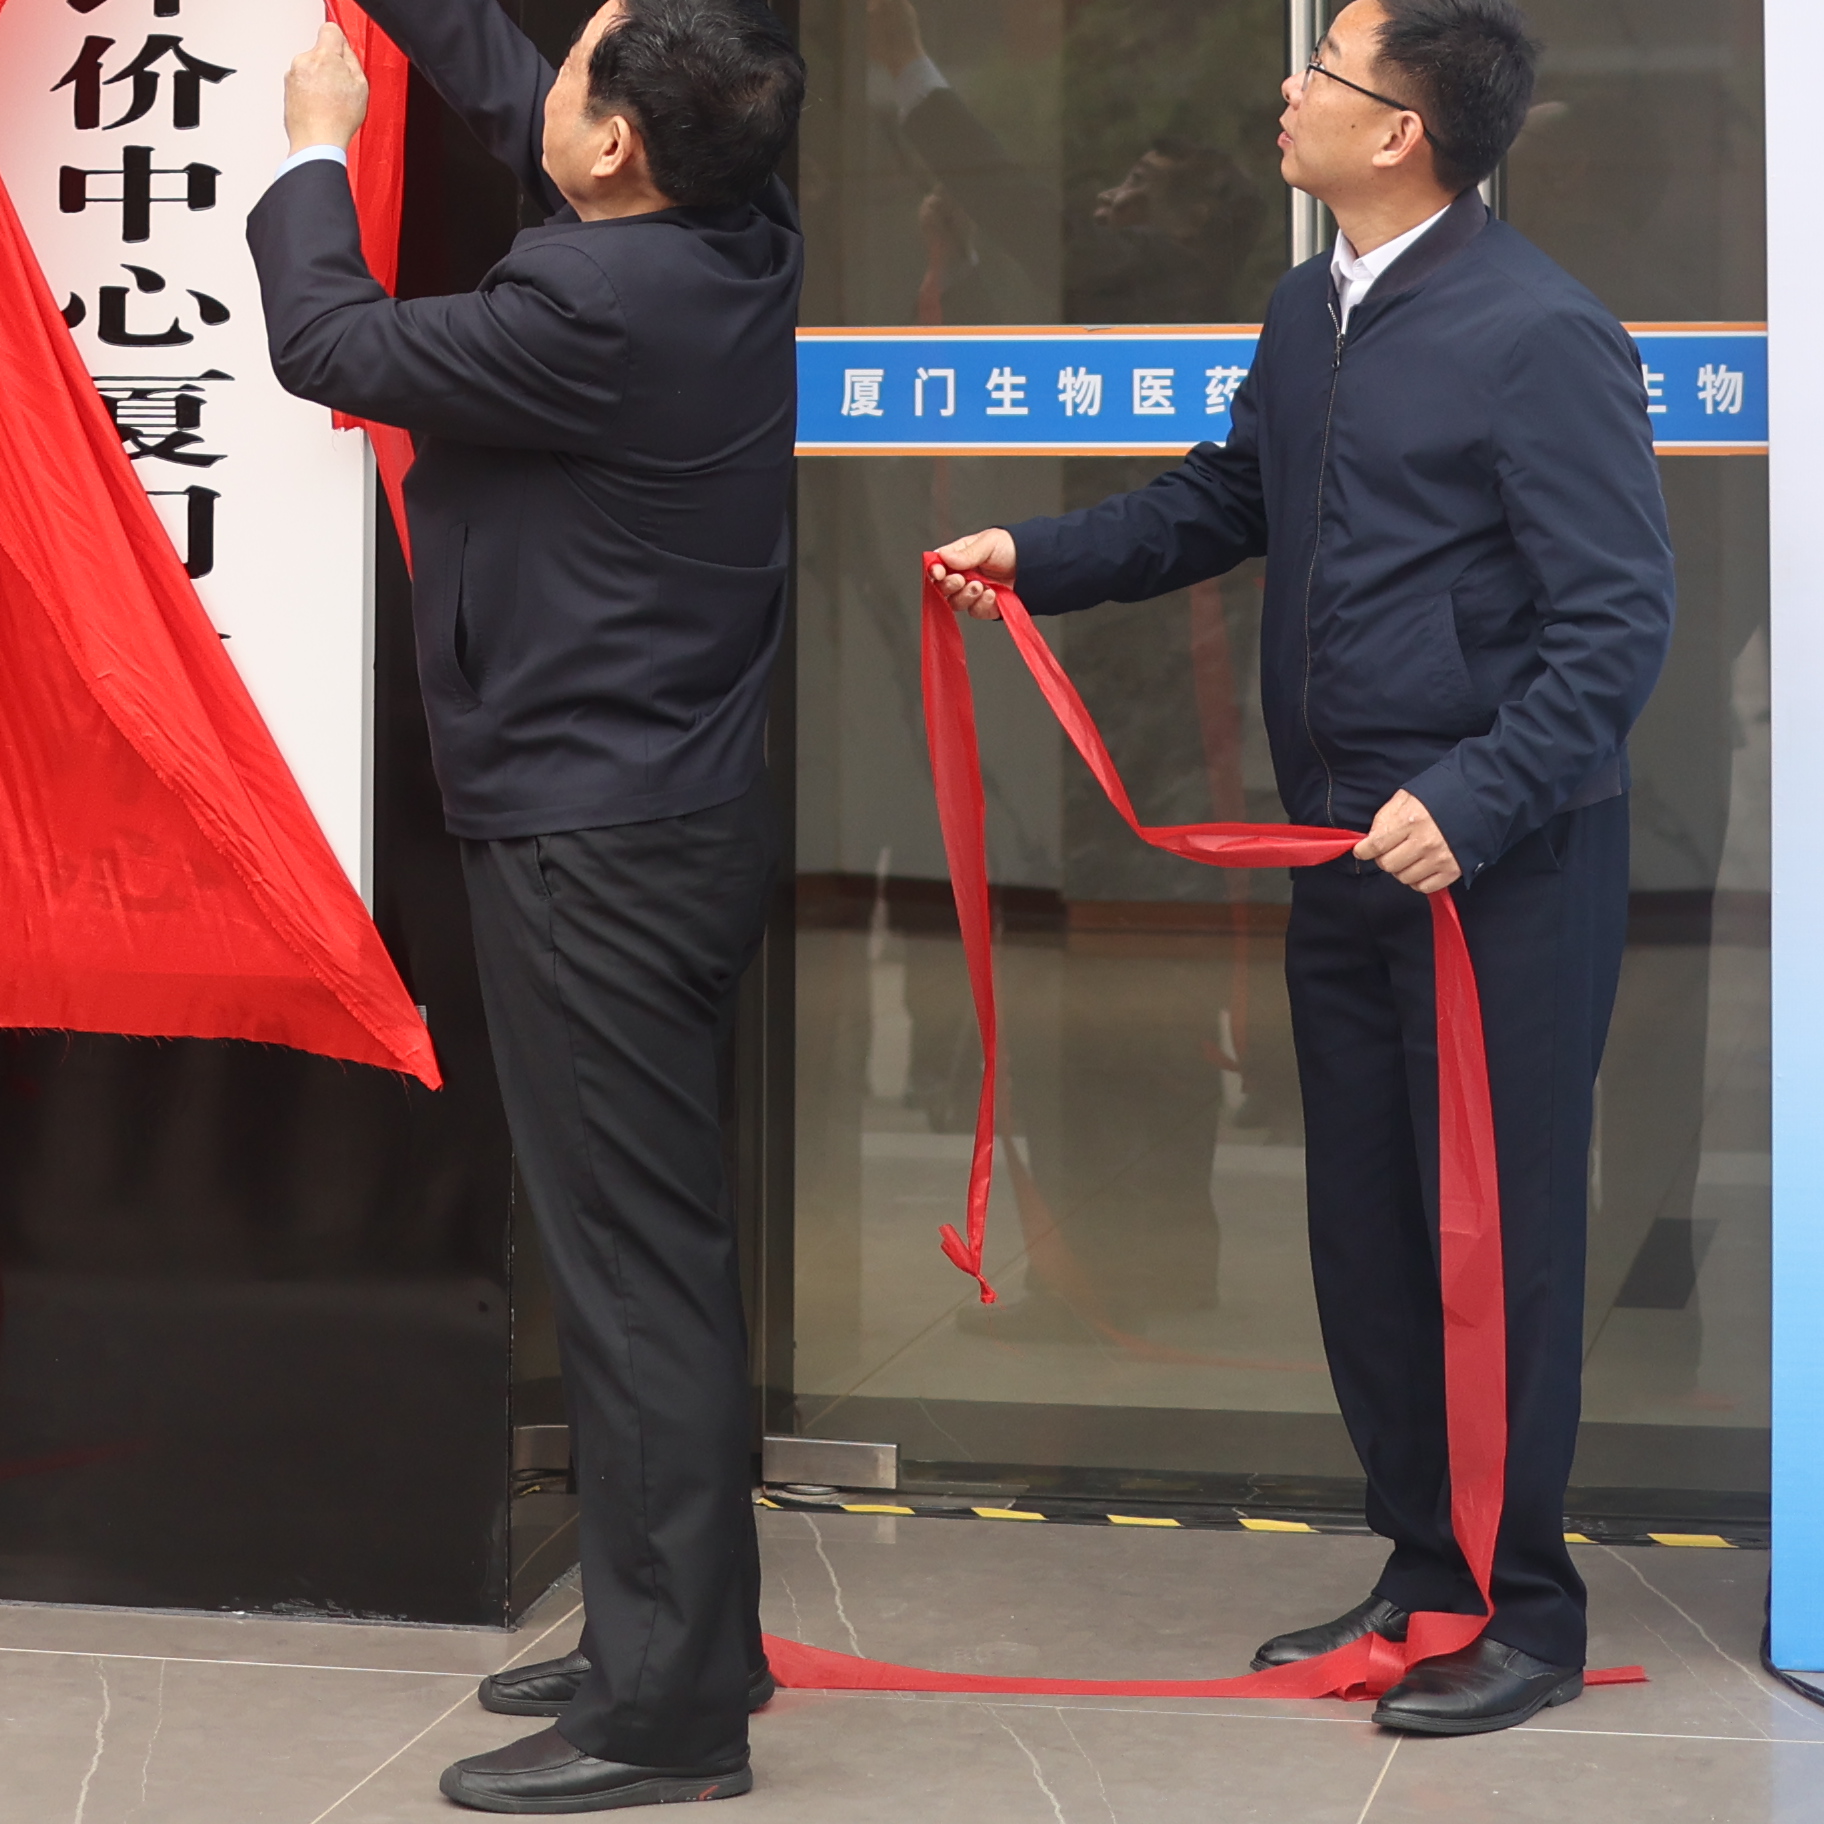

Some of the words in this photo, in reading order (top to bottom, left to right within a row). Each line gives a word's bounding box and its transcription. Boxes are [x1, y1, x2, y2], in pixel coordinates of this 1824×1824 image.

[840, 365, 1250, 417] 厦门生物医药
